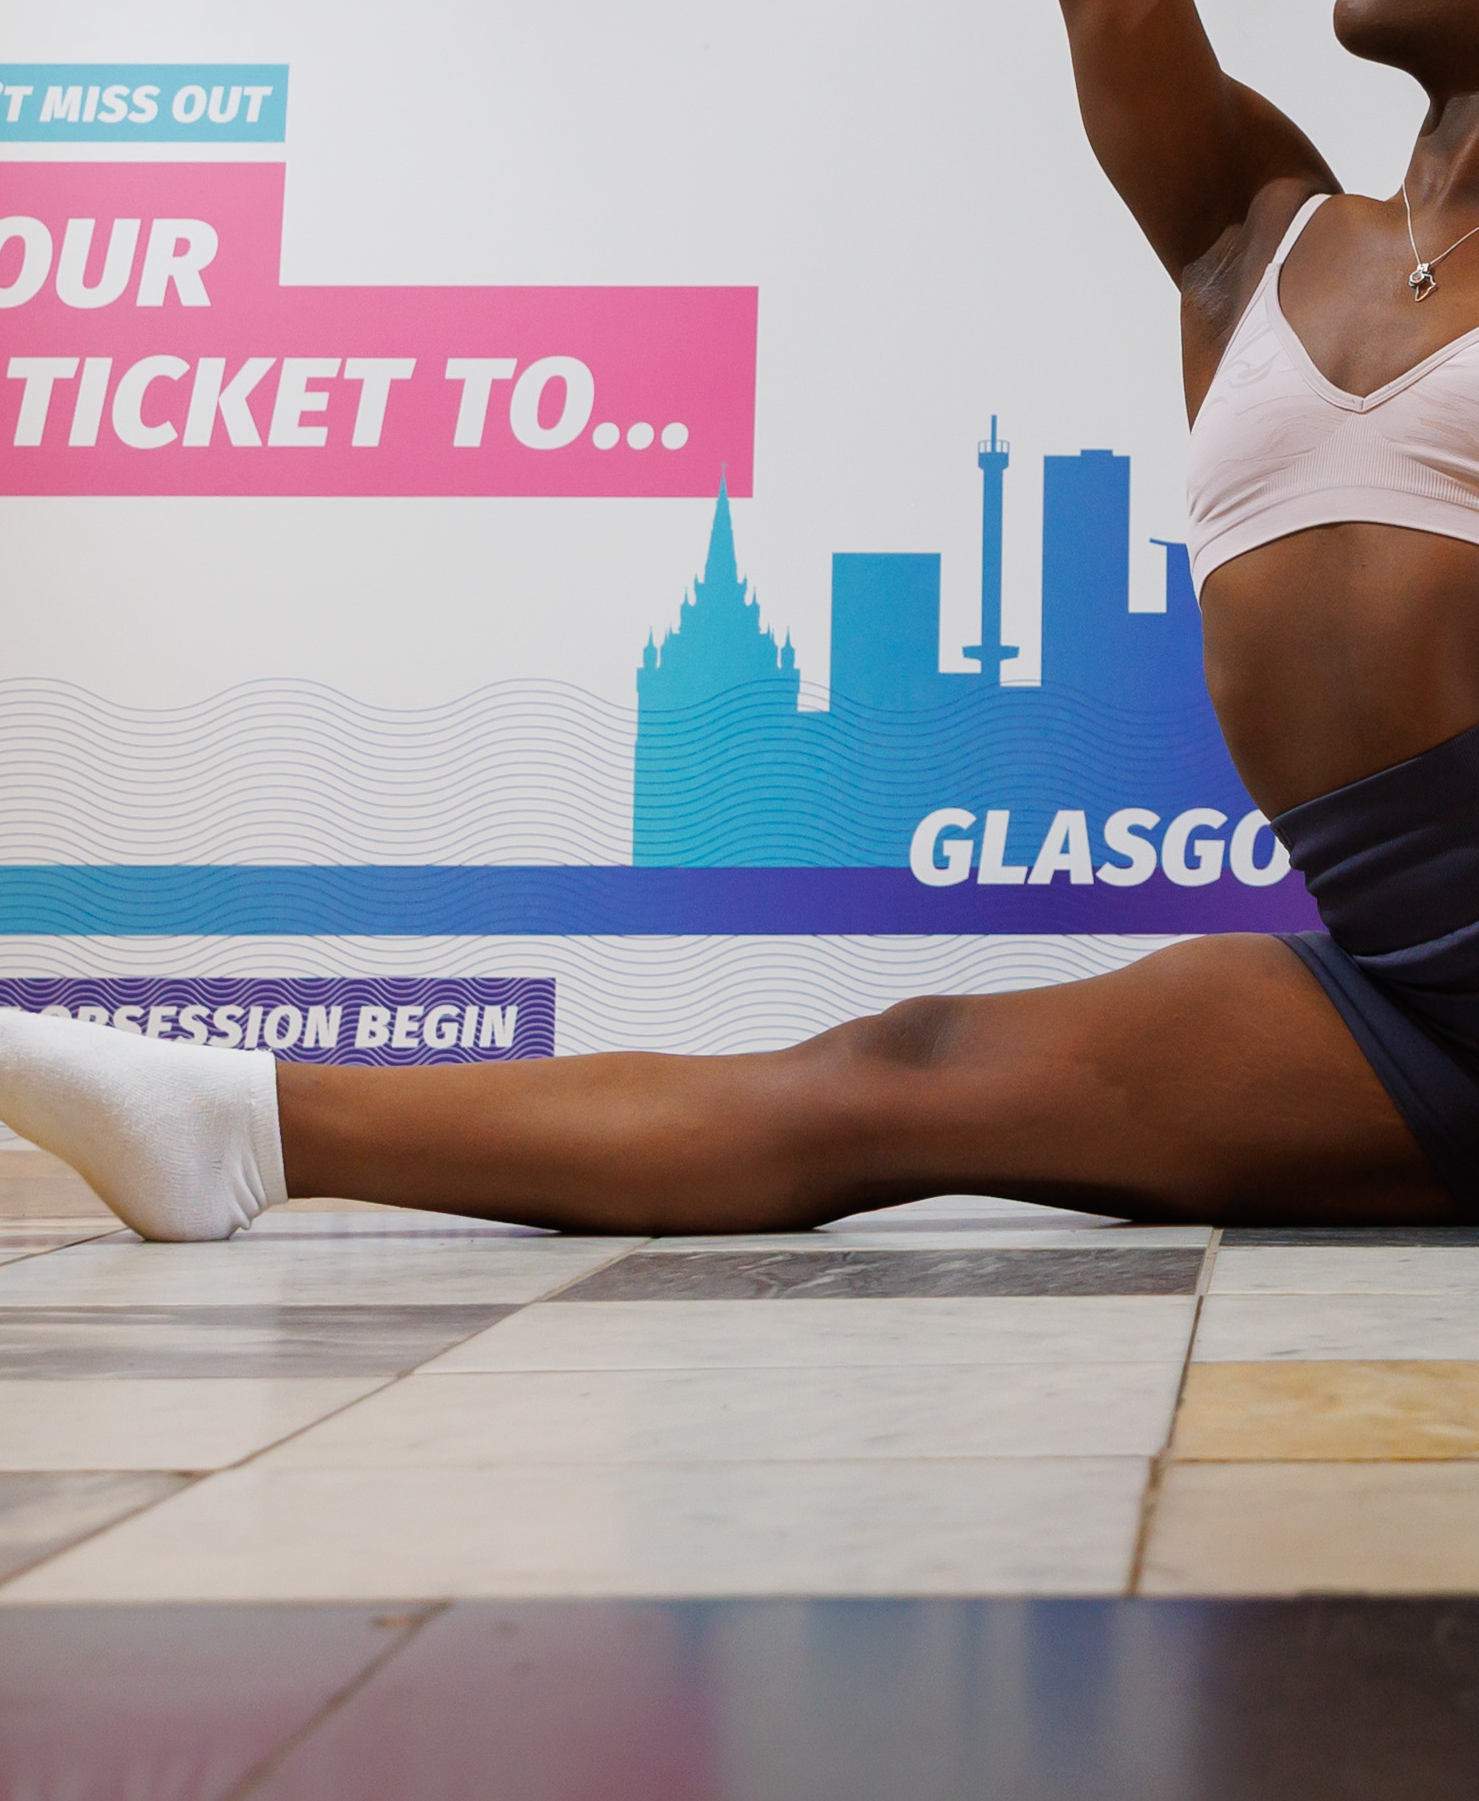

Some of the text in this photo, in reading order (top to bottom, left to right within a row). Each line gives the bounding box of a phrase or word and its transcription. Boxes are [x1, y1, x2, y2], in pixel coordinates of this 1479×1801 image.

[39, 84, 161, 124] MISS
[171, 84, 274, 124] OUT
[6, 354, 689, 450] TICKET TO...
[909, 807, 1293, 887] GLASGO
[40, 1003, 344, 1050] SESSION
[354, 1003, 520, 1050] BEGIN
